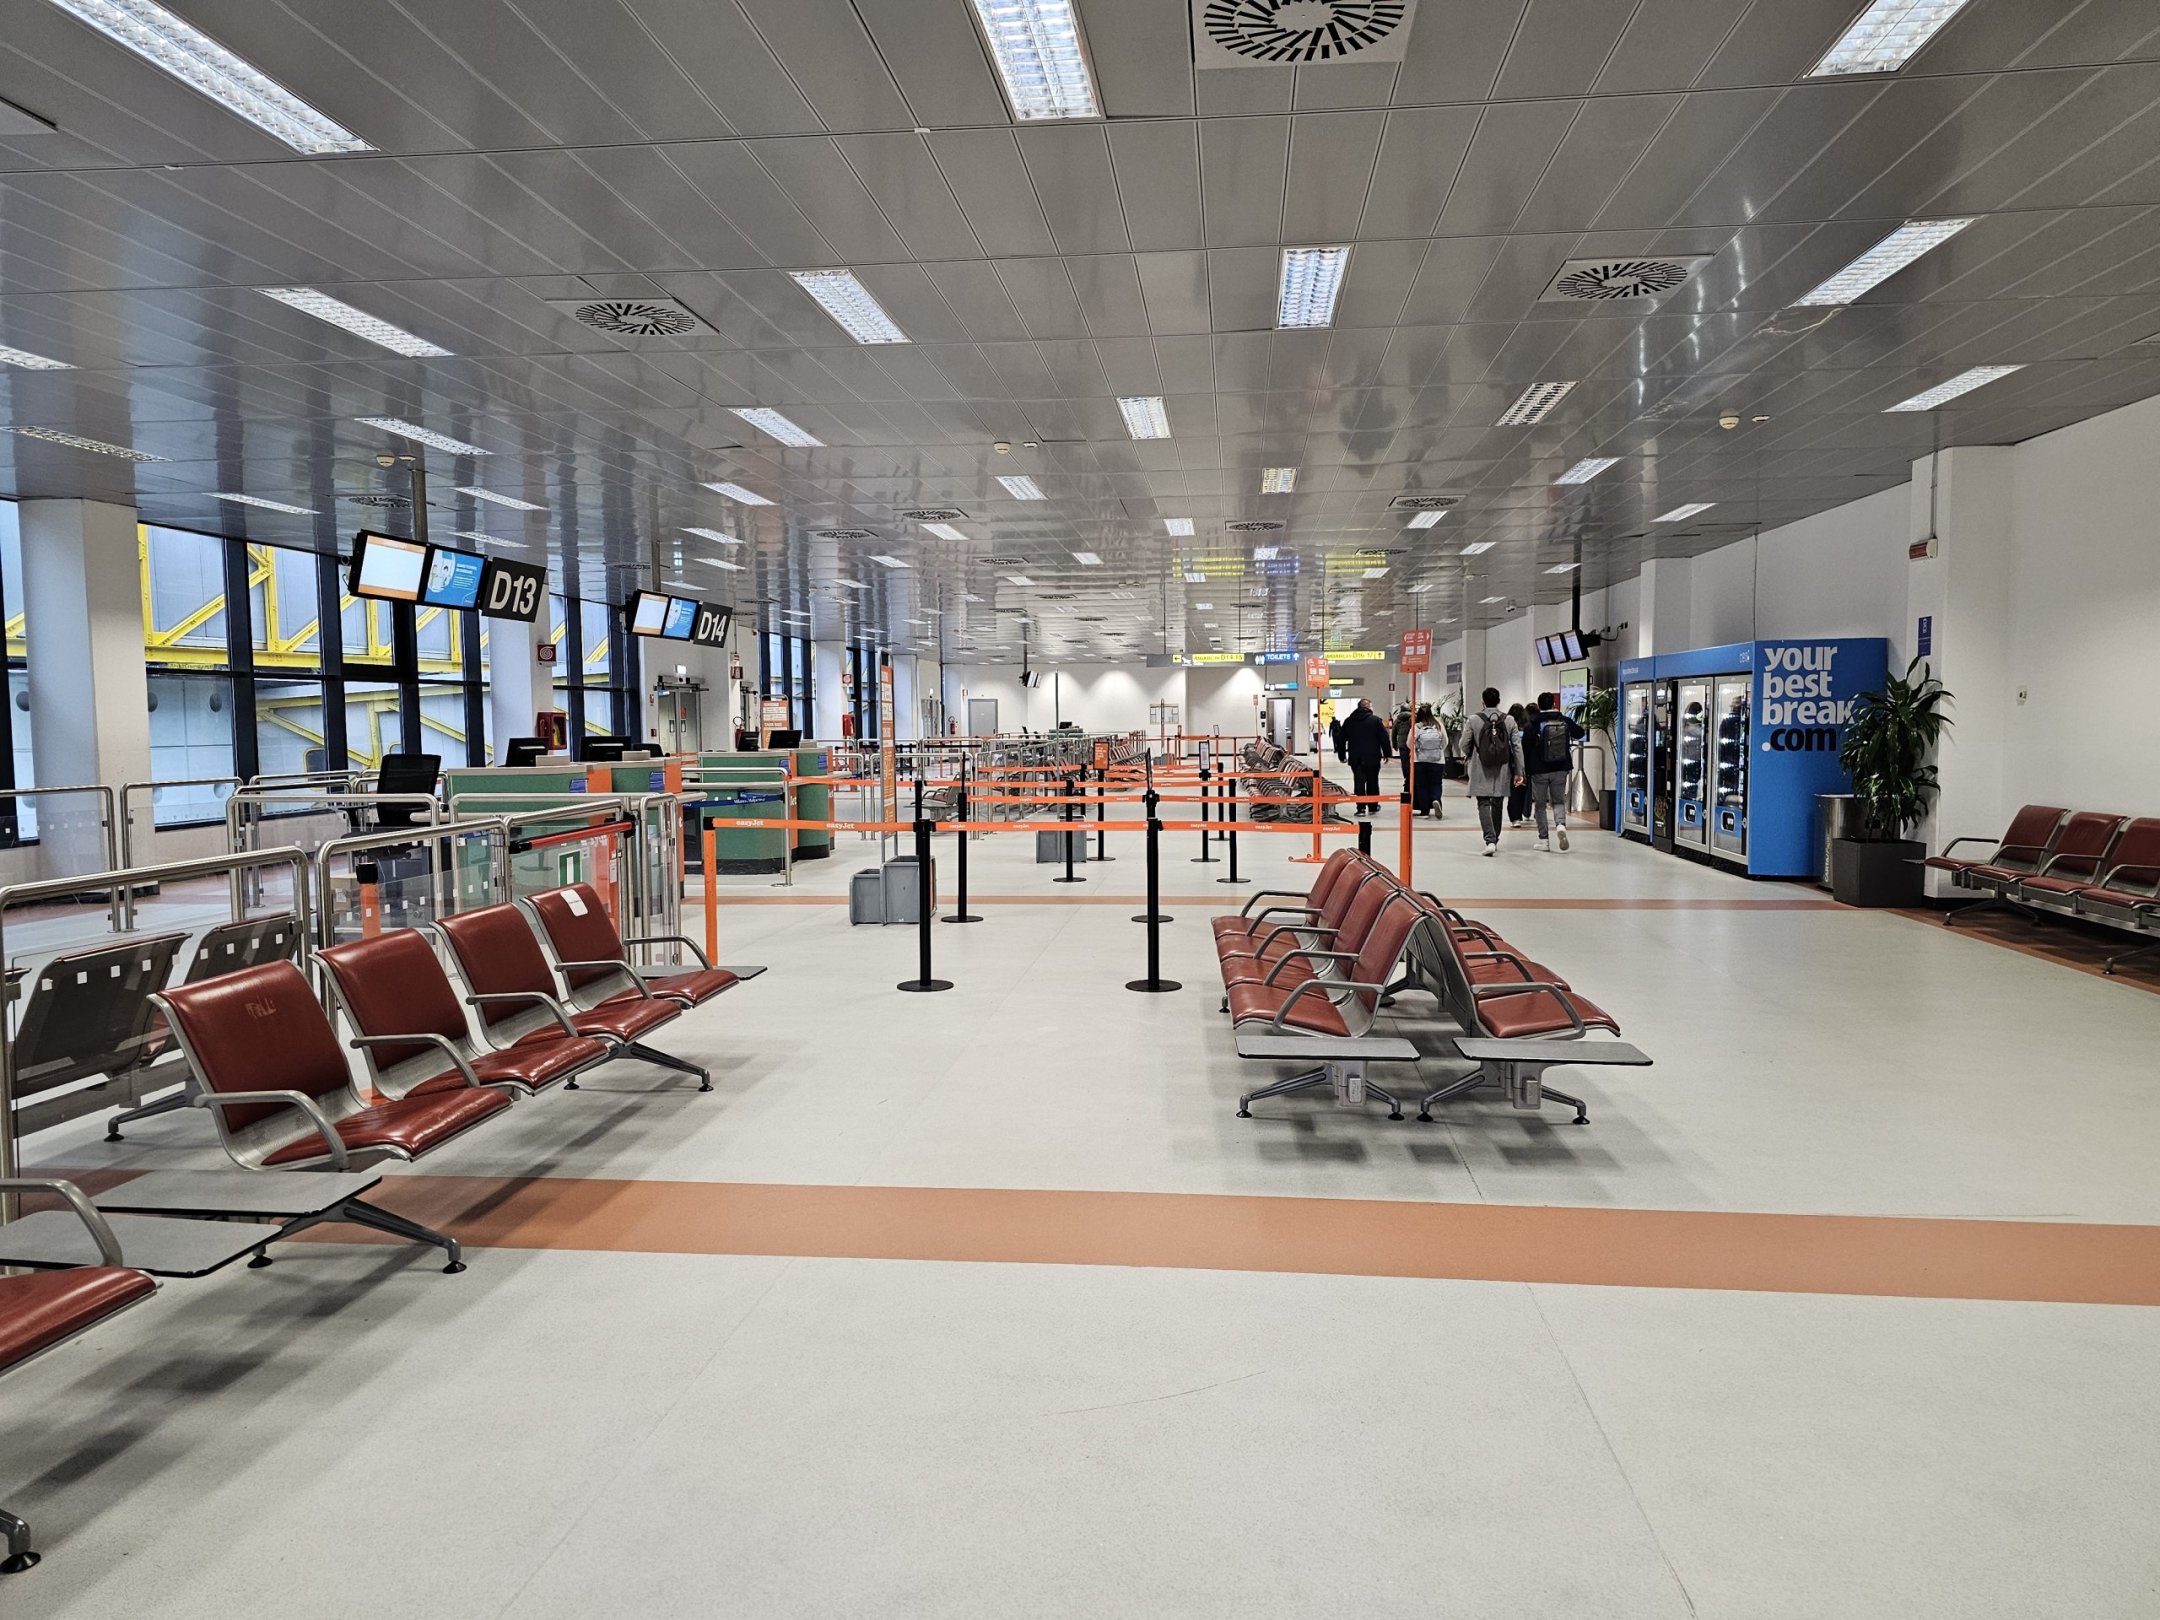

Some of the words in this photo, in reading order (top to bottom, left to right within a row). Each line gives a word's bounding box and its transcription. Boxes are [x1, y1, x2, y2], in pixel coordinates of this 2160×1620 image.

[489, 570, 537, 615] D13
[698, 611, 727, 642] D14
[1764, 646, 1838, 672] your
[1763, 671, 1833, 698] best
[1762, 699, 1856, 725] break
[1761, 727, 1837, 752] .com
[736, 819, 764, 827] easyJet
